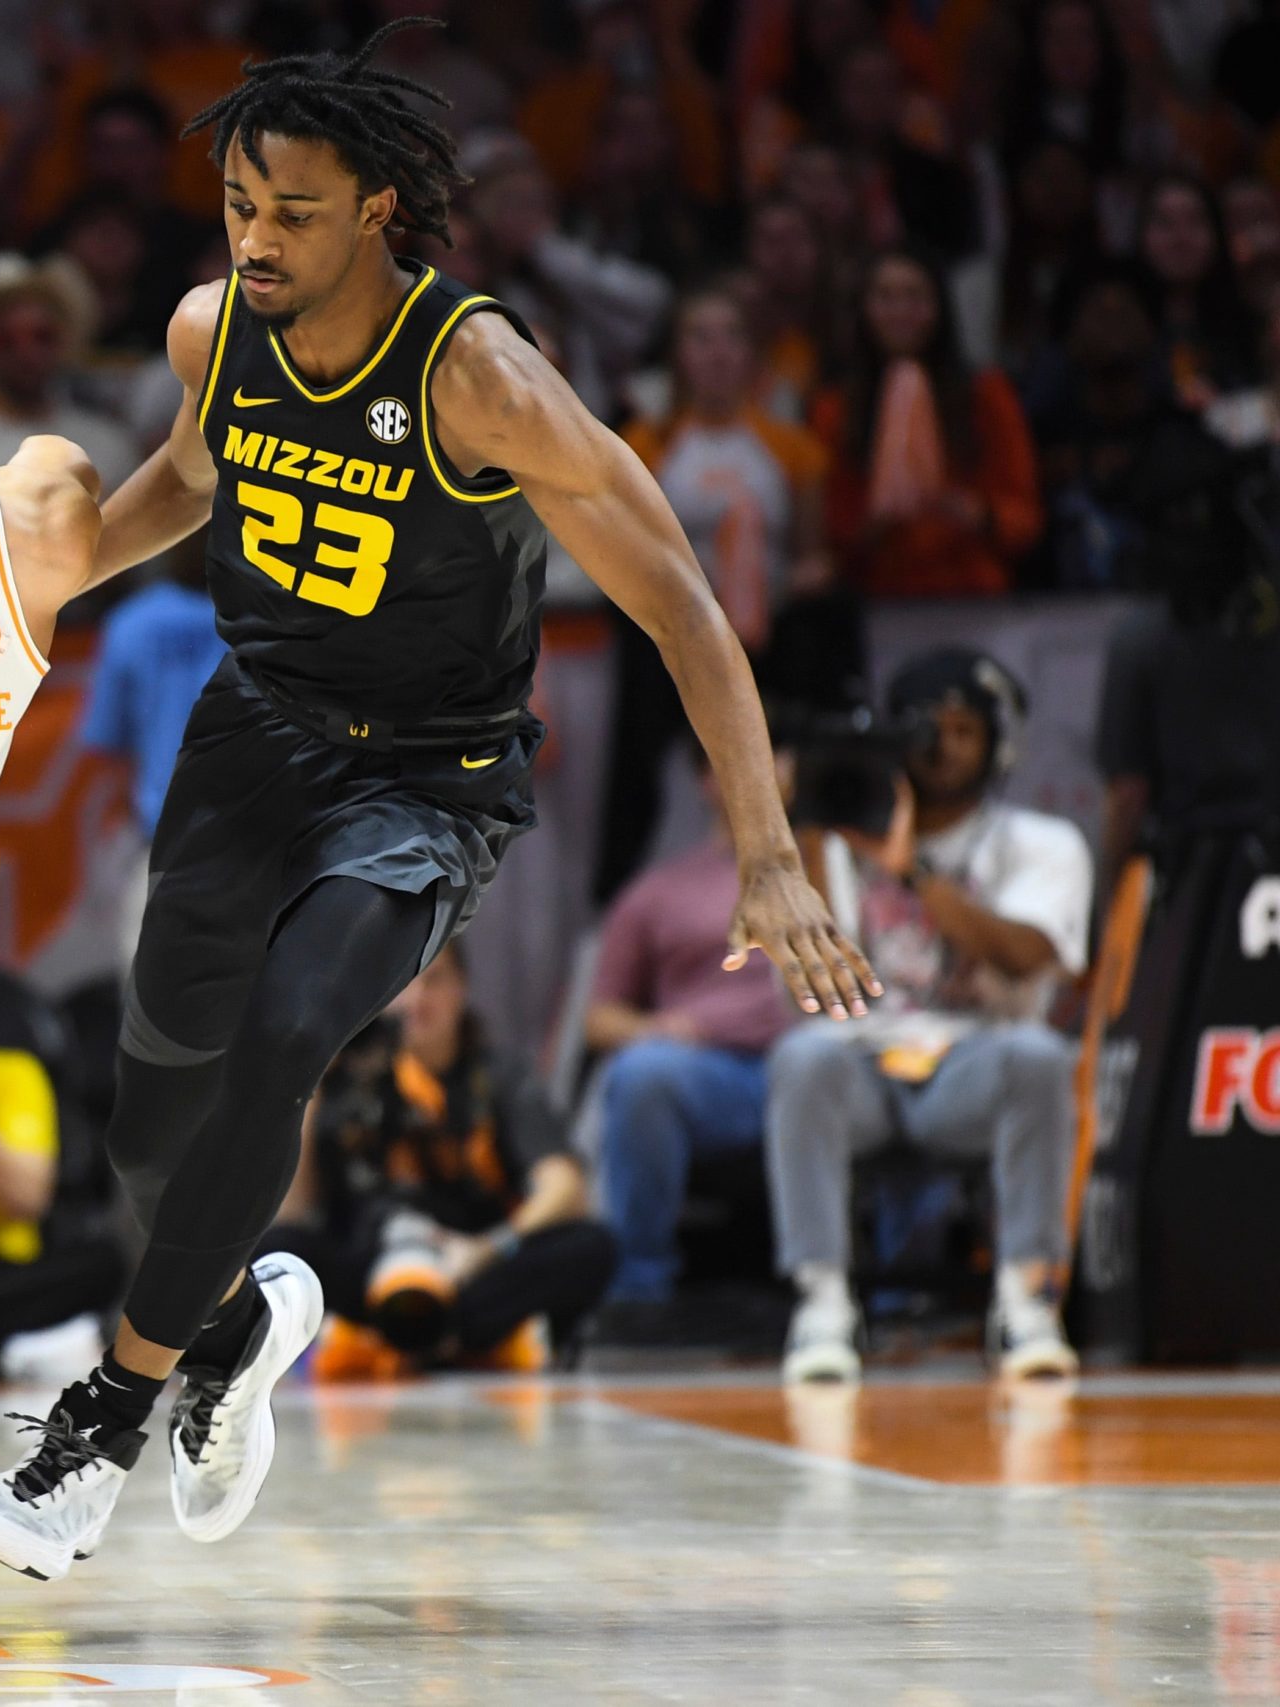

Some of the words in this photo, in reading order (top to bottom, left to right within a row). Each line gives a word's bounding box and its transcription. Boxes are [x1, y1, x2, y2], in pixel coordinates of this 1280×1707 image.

[369, 399, 409, 441] SEC
[223, 424, 416, 501] MIZZOU
[237, 481, 395, 617] 23
